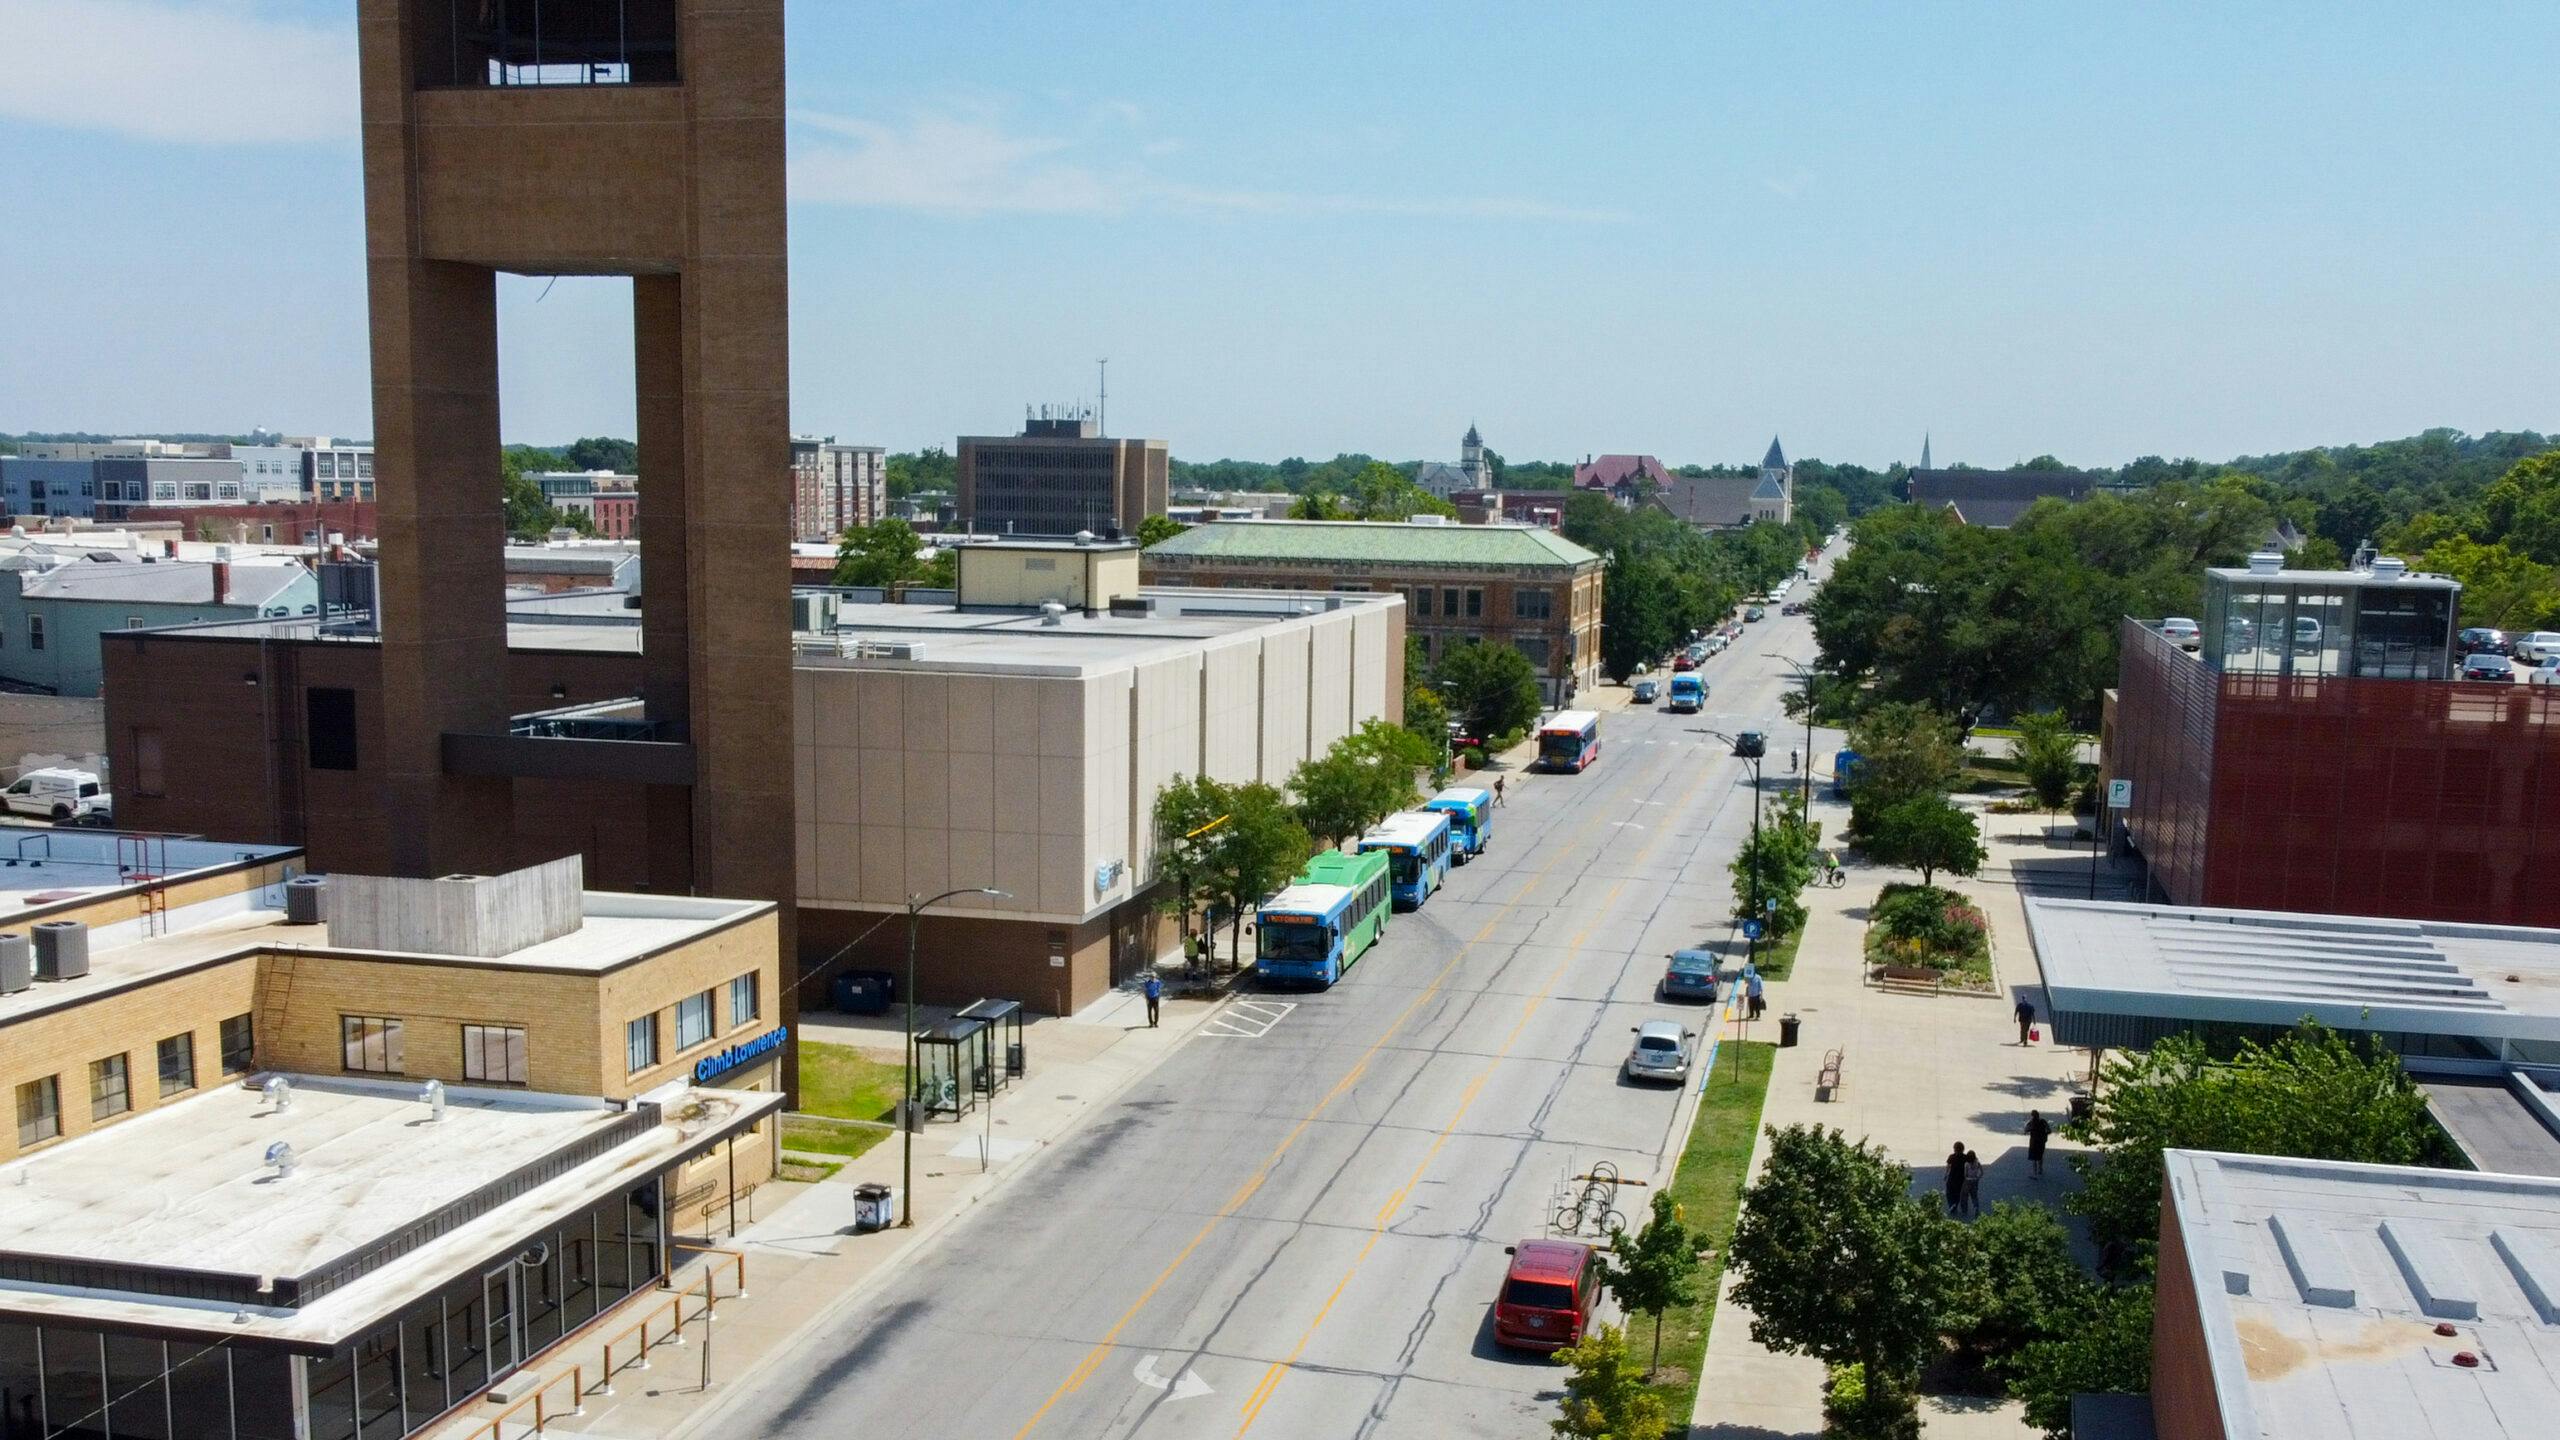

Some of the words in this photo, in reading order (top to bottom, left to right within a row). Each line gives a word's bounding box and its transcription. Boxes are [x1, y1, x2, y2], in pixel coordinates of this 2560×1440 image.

[2115, 784, 2125, 796] P
[696, 1048, 733, 1083] Climb
[734, 1024, 788, 1065] Lawrence
